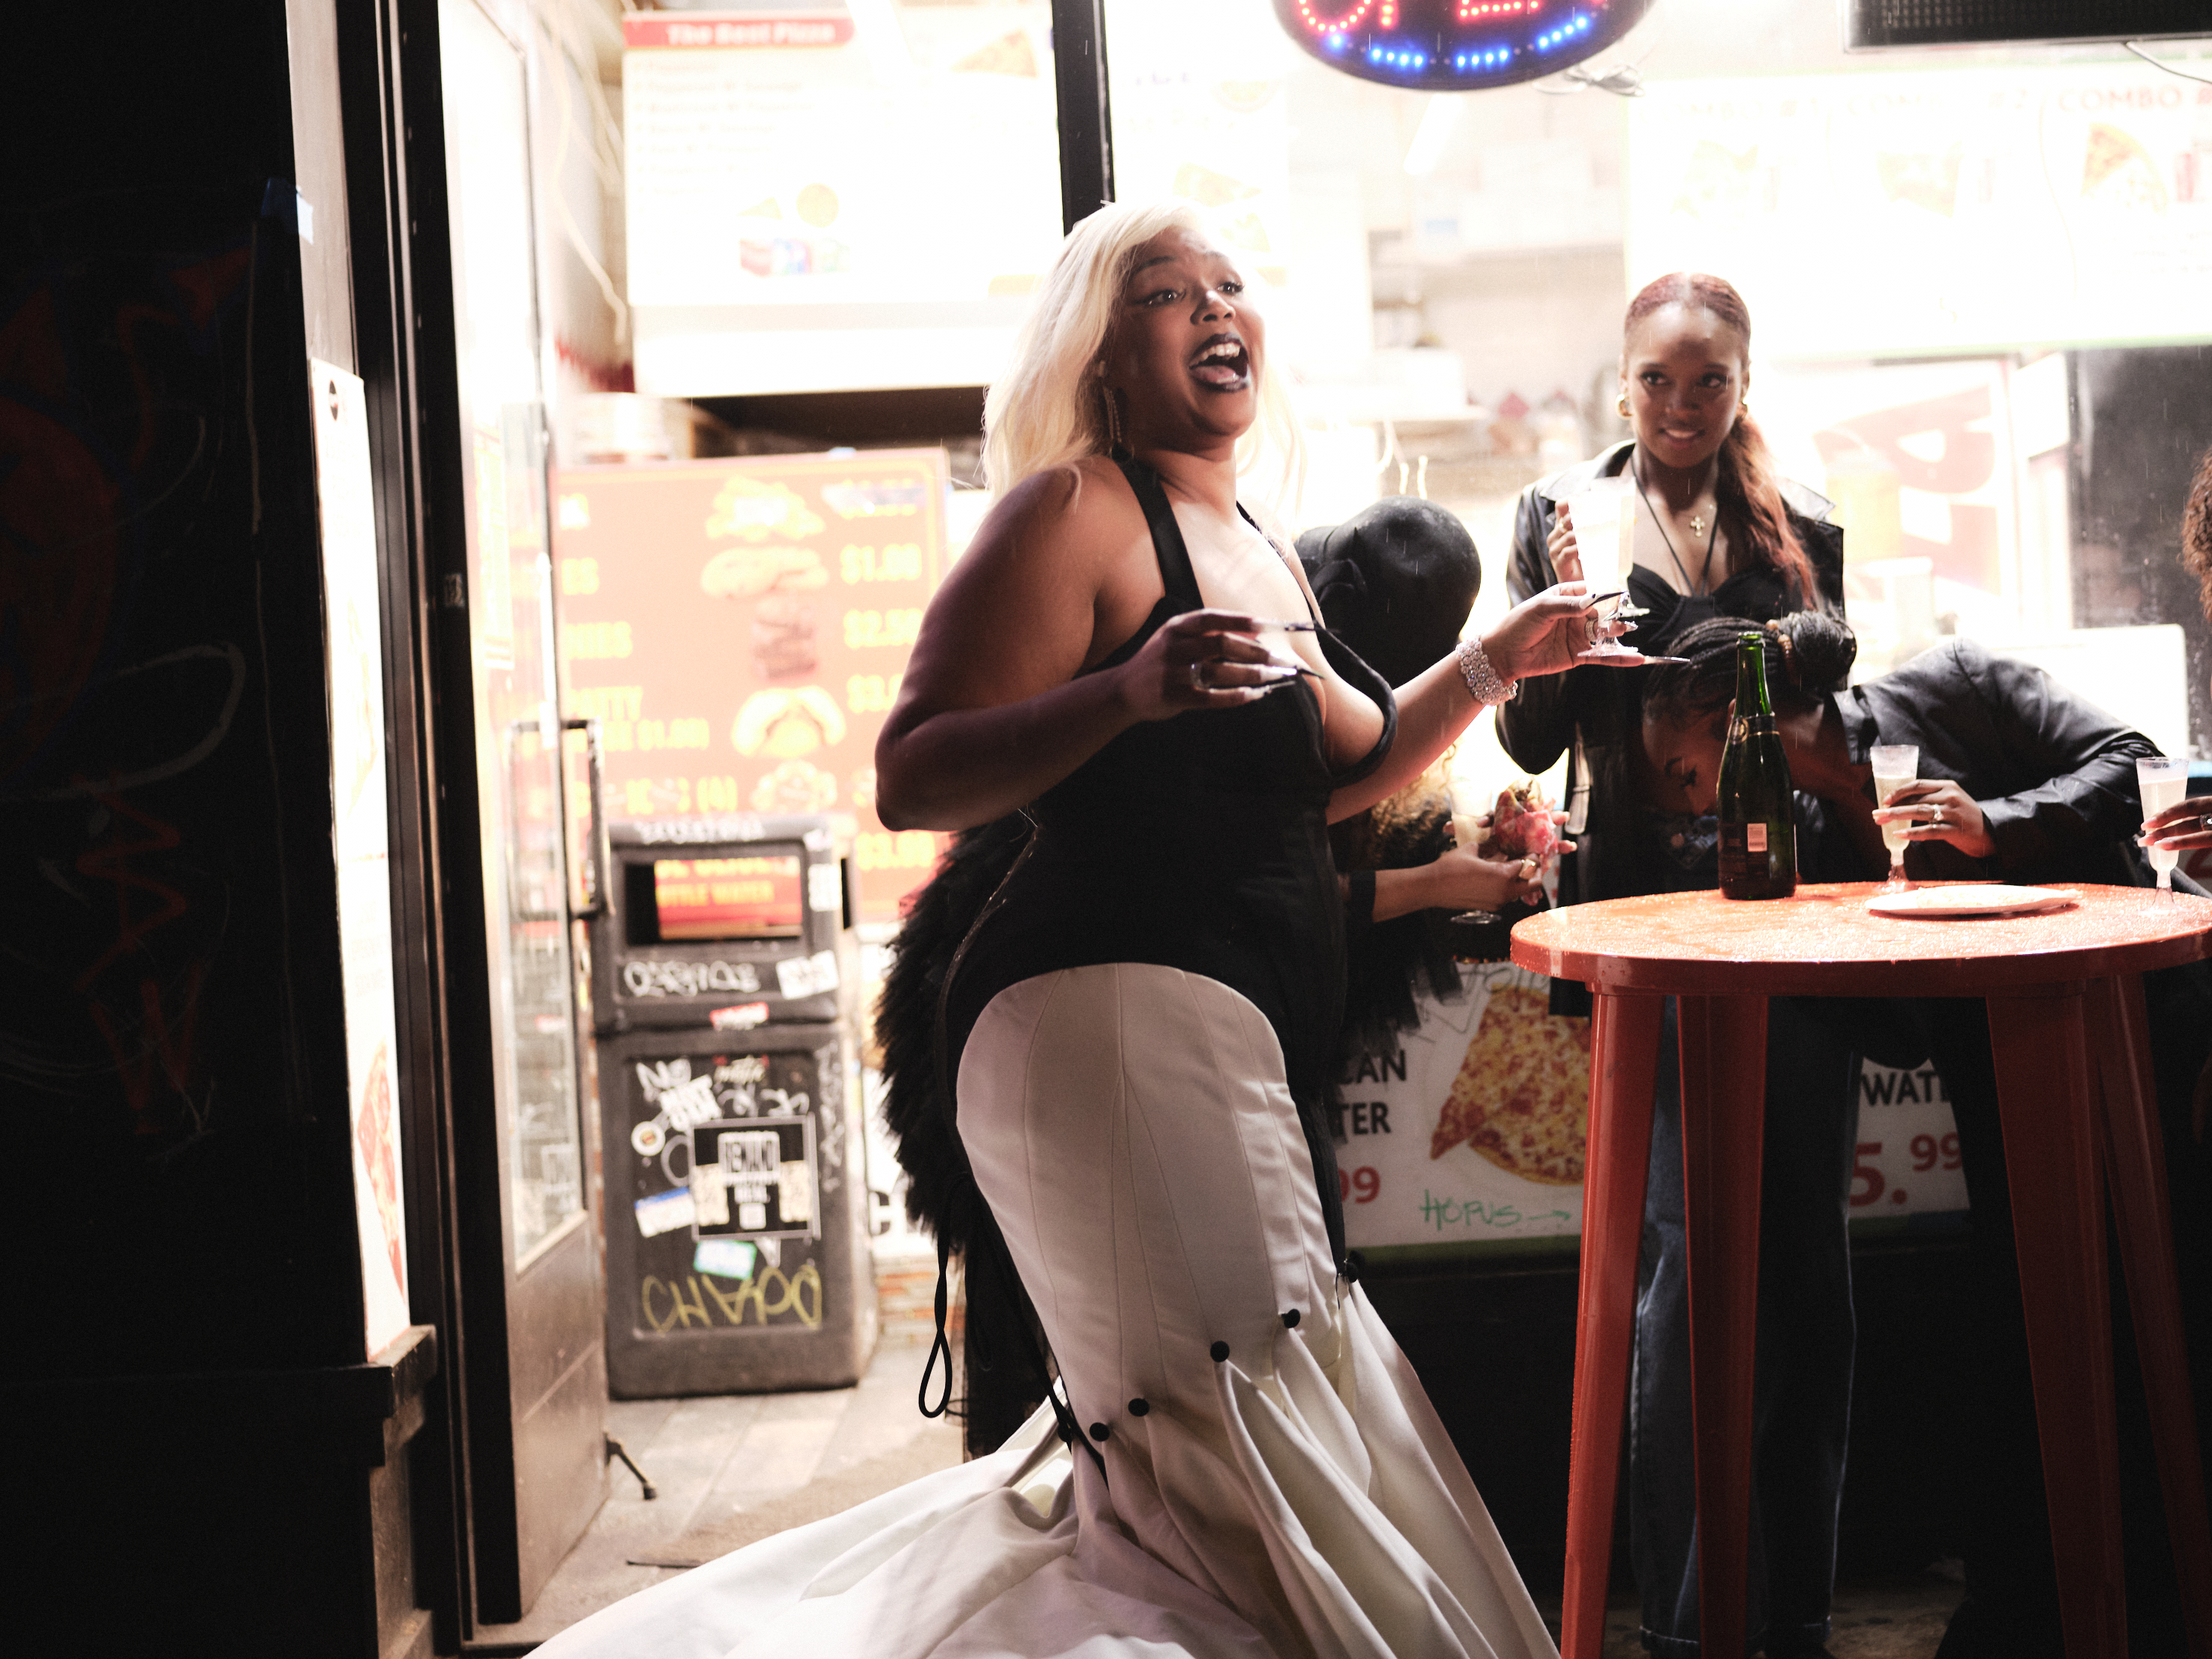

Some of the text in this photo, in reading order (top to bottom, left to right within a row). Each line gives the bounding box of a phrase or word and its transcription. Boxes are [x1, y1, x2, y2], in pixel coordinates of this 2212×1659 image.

[668, 23, 713, 45] The
[715, 22, 771, 45] Best
[2057, 82, 2183, 113] COMBO
[1339, 1049, 1406, 1084] AN
